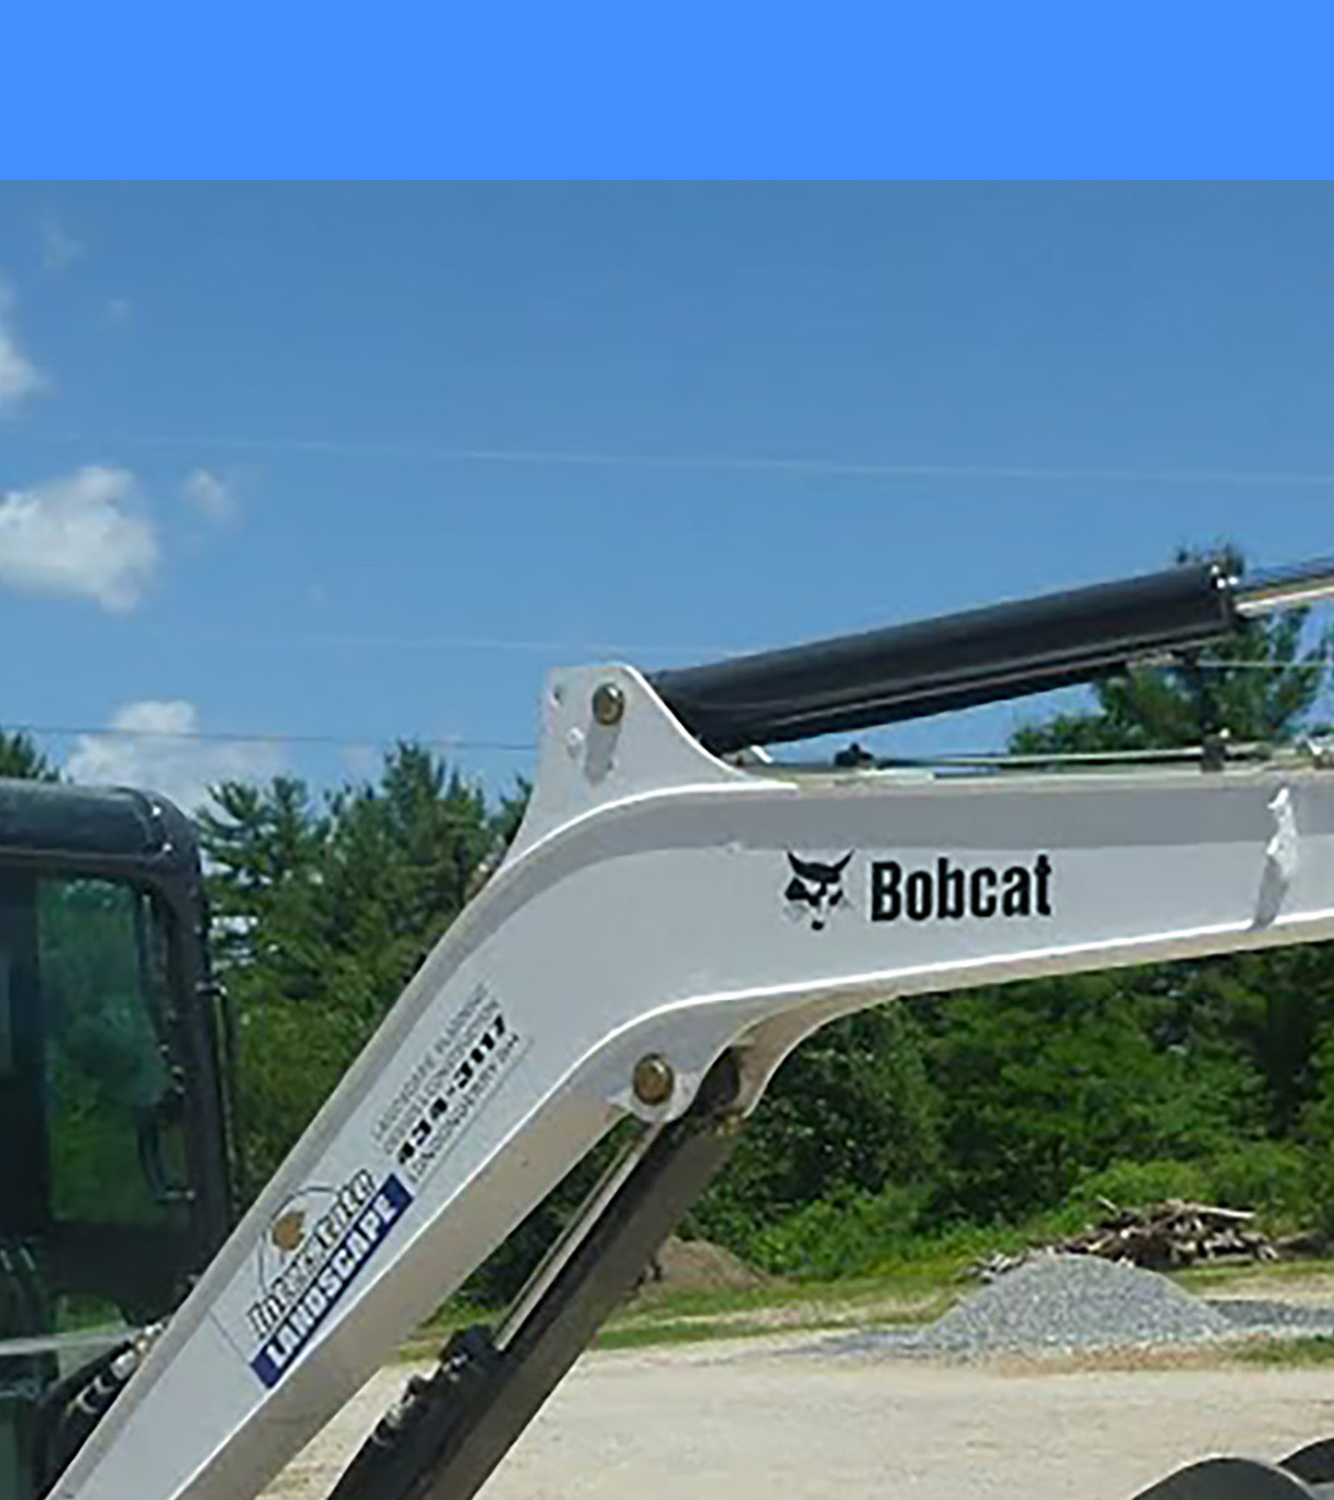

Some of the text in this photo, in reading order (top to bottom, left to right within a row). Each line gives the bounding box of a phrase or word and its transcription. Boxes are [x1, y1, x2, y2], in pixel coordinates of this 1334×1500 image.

[871, 853, 1052, 922] Bobcat
[397, 1013, 505, 1165] 434-3117
[265, 1192, 401, 1370] LANDSCAPE
